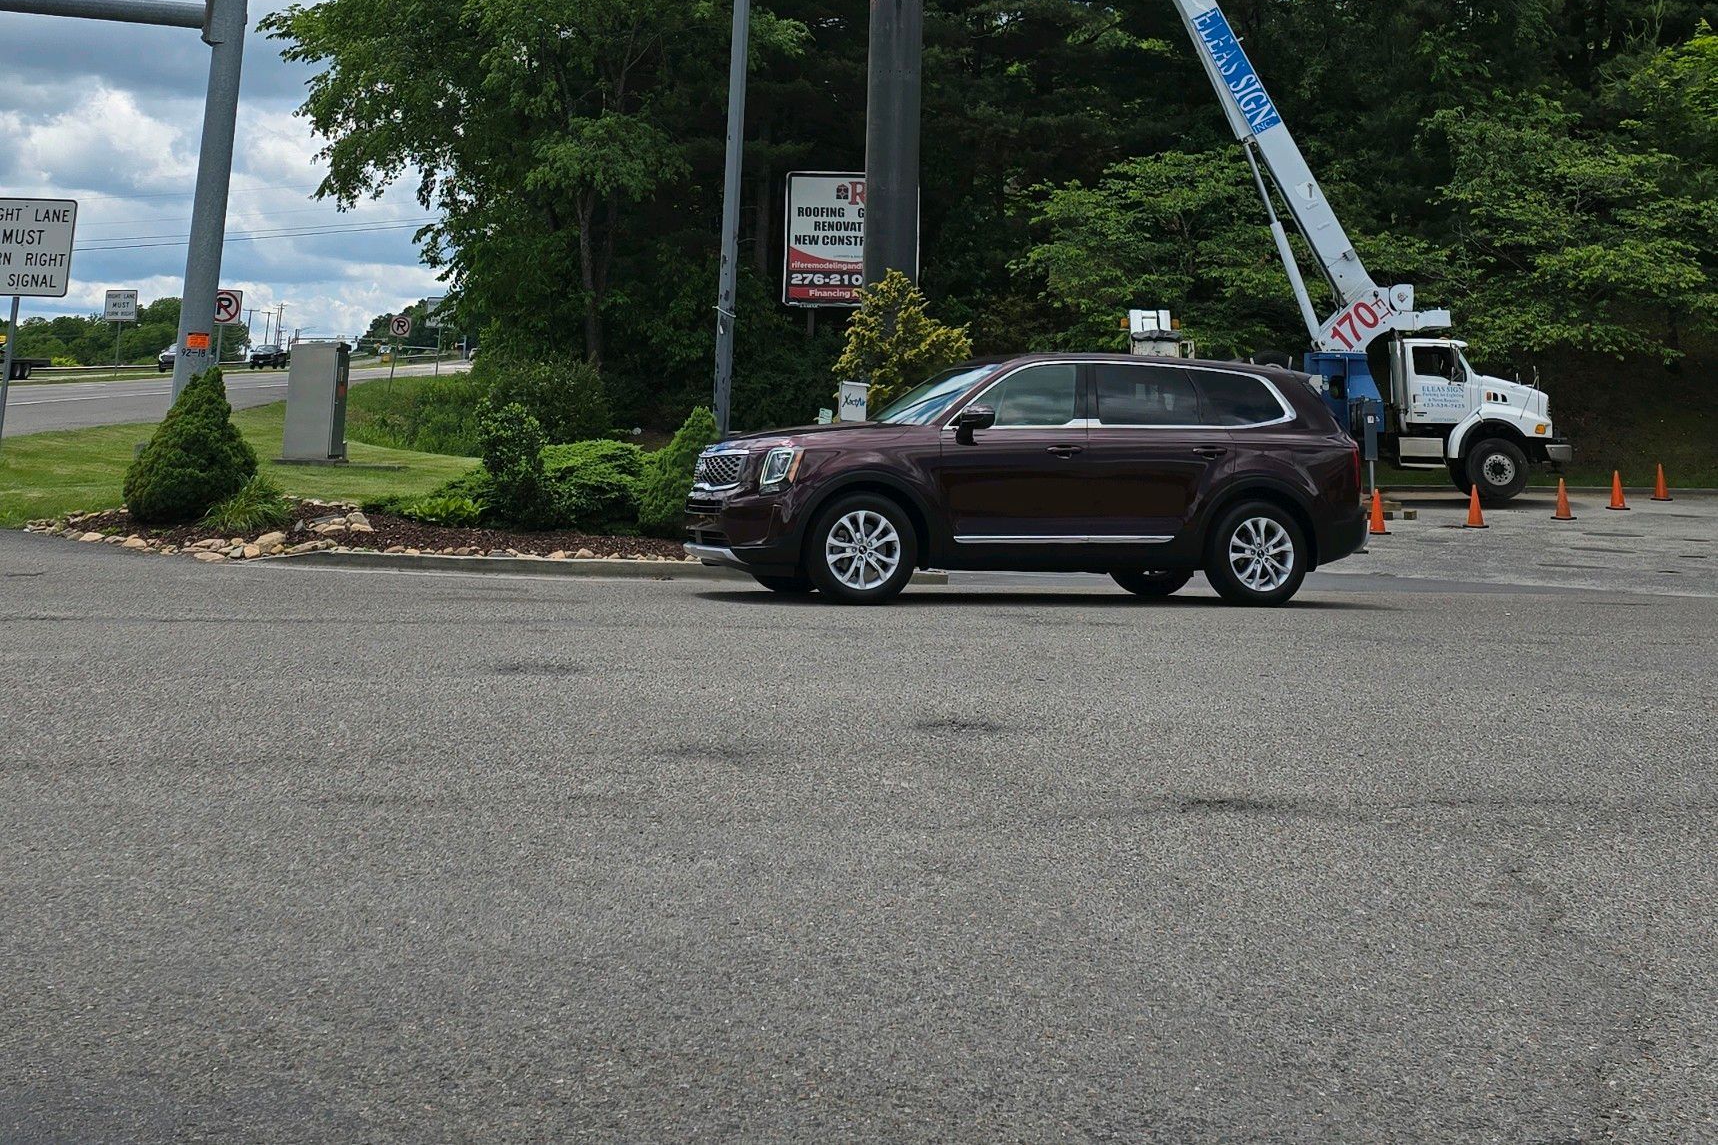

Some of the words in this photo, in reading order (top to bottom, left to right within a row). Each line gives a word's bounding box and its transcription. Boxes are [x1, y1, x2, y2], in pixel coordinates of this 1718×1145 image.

[1193, 8, 1244, 76] ELEAS
[1229, 74, 1276, 127] SIGN
[34, 209, 70, 223] LANE
[797, 206, 845, 218] ROOFING
[2, 229, 45, 245] MUST
[794, 235, 819, 246] NEW
[25, 252, 66, 267] RIGHT
[7, 274, 57, 288] SIGNAL
[809, 289, 850, 299] Financing
[1330, 302, 1379, 350] 170
